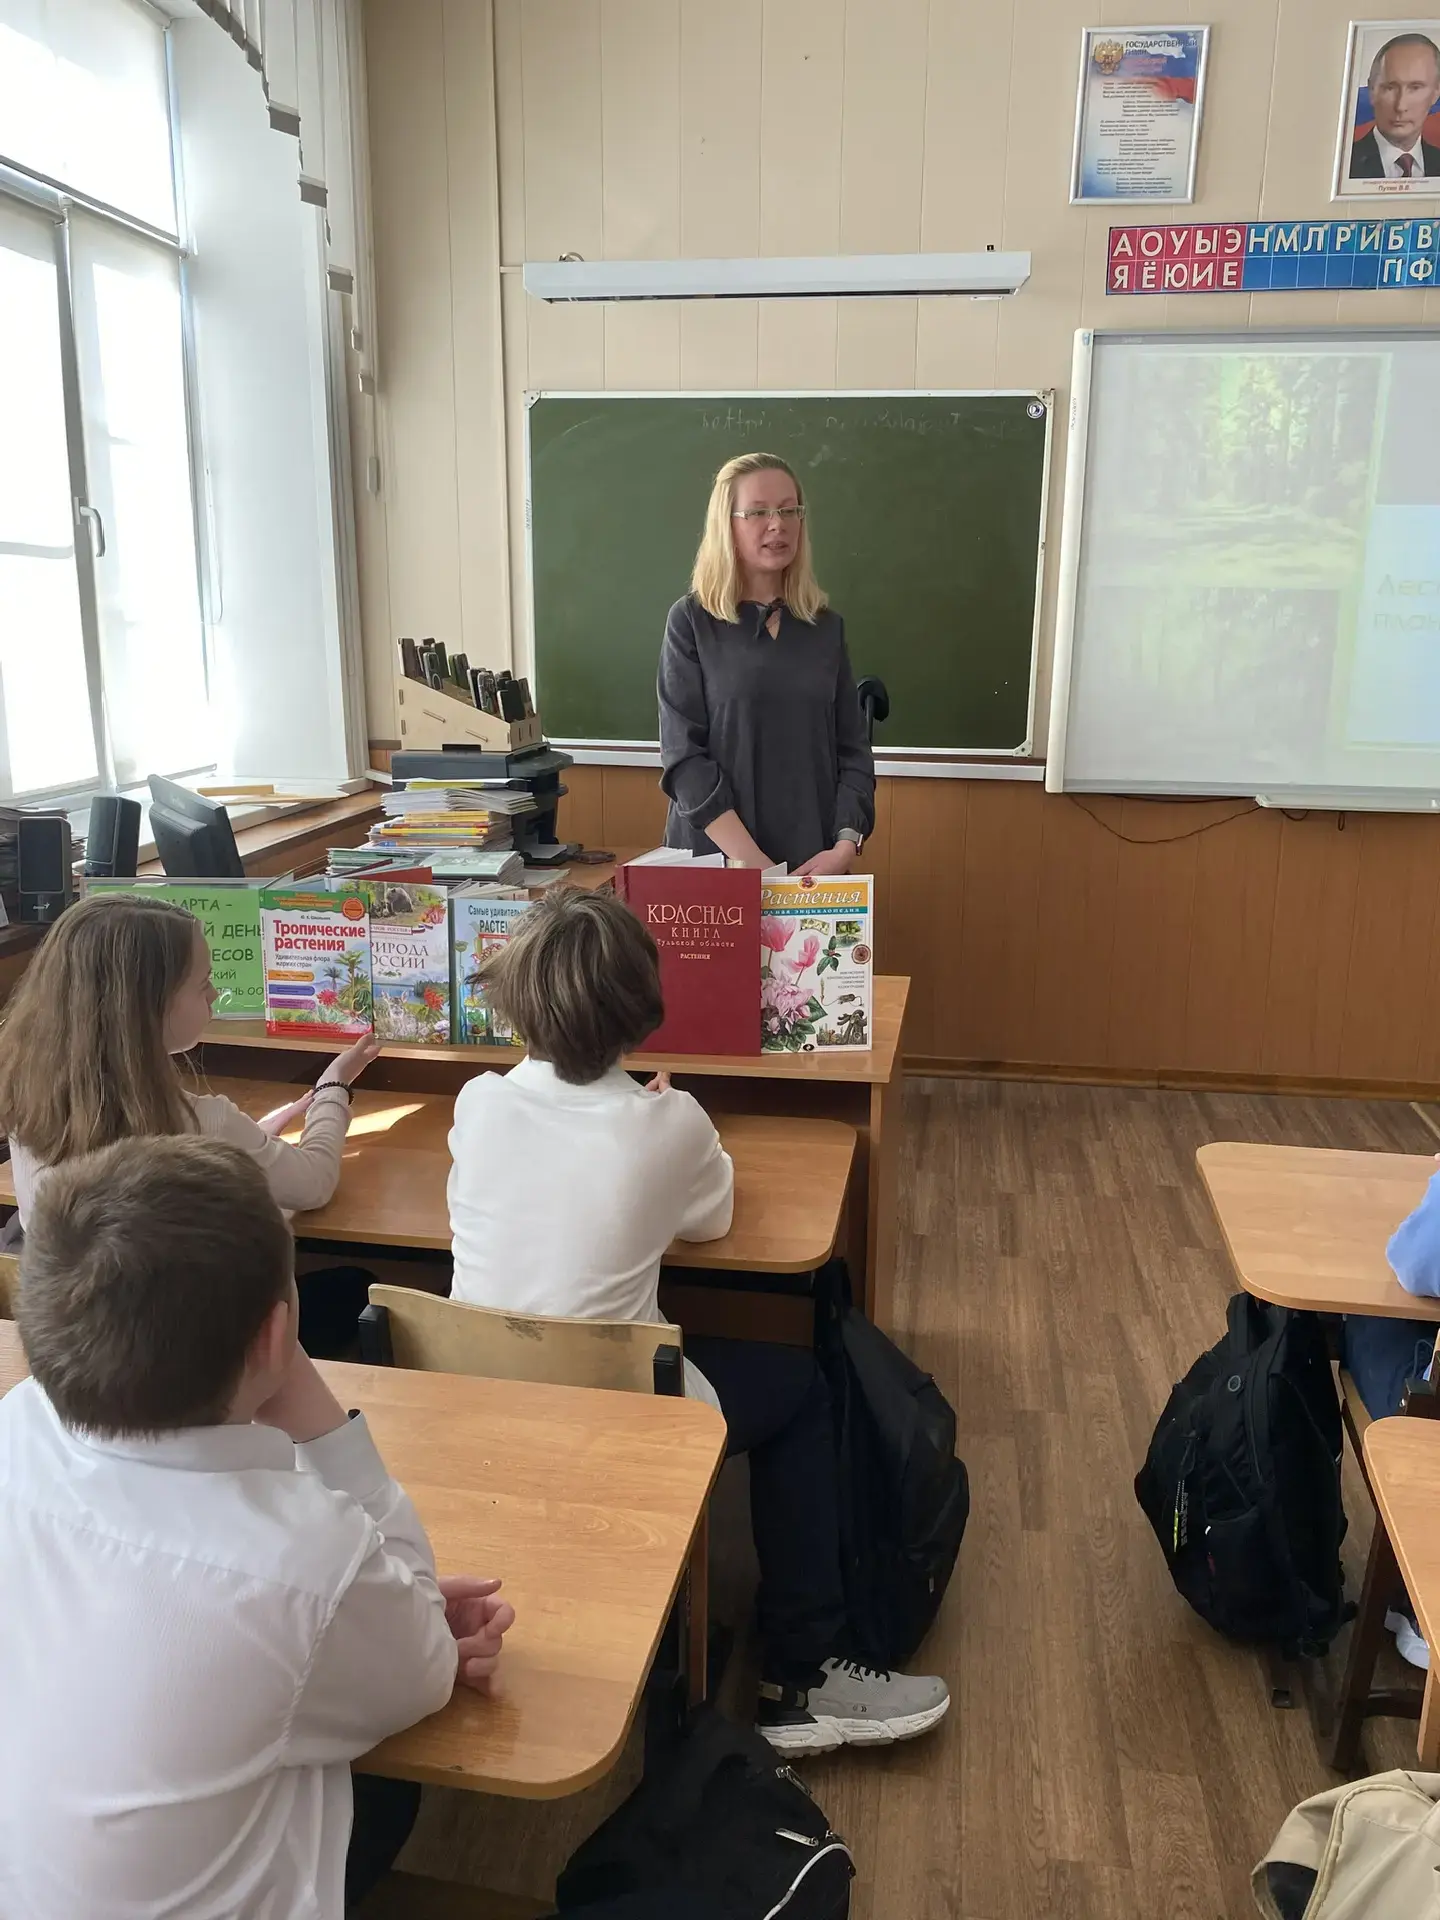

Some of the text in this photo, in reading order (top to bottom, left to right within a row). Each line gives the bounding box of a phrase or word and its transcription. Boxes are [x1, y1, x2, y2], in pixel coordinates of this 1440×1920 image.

[761, 888, 861, 905] Растения
[646, 903, 744, 926] КРАСНАЯ
[794, 907, 860, 915] ЭНЦИКЛОПЕДИЯ
[273, 919, 366, 937] Тропические
[479, 920, 508, 933] РАСТЕ
[671, 927, 721, 939] КНИГА
[274, 936, 346, 951] растения
[370, 941, 429, 956] ИРОДА
[656, 938, 735, 948] Тульской области
[211, 948, 254, 962] ЕСОВ
[371, 954, 425, 969] ОССИИ
